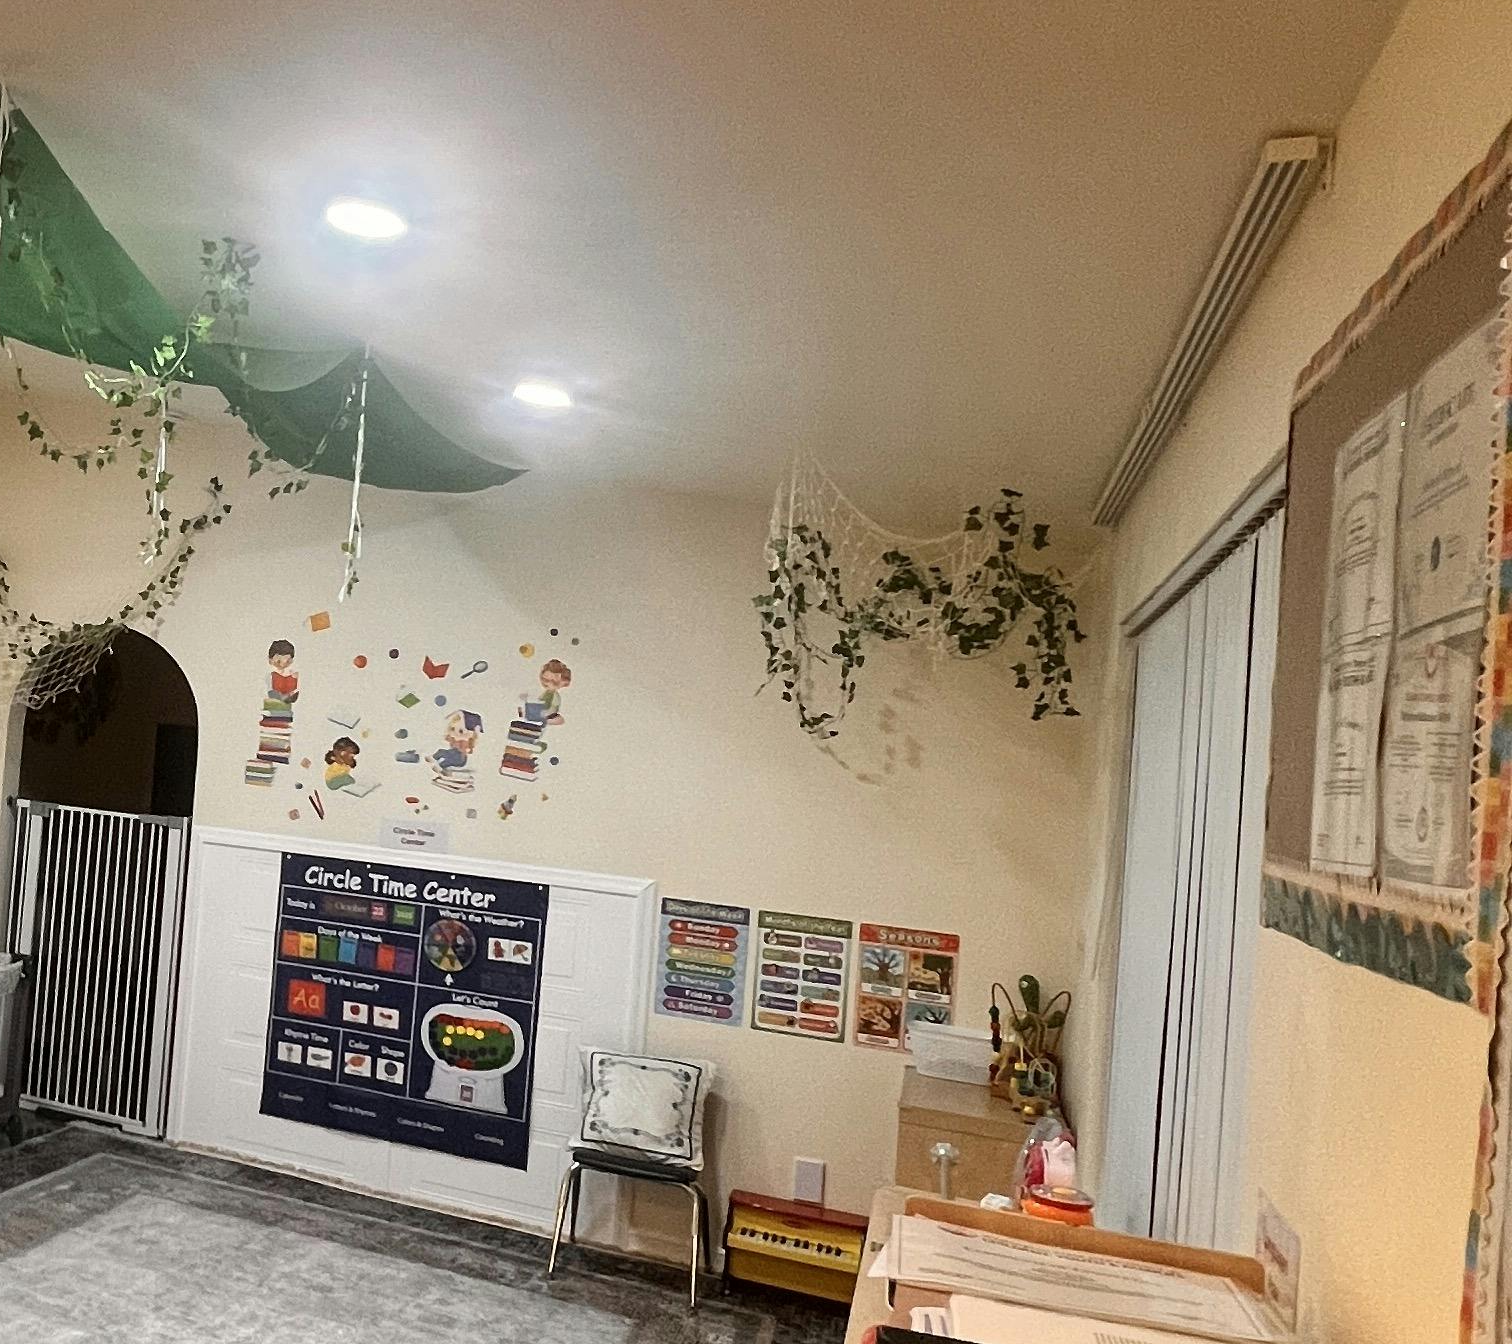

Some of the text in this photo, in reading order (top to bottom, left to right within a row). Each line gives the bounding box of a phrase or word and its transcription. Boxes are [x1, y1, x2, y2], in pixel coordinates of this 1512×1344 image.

[304, 866, 496, 908] Circle Time Center
[879, 929, 940, 946] Seasons
[293, 988, 319, 1009] Aa
